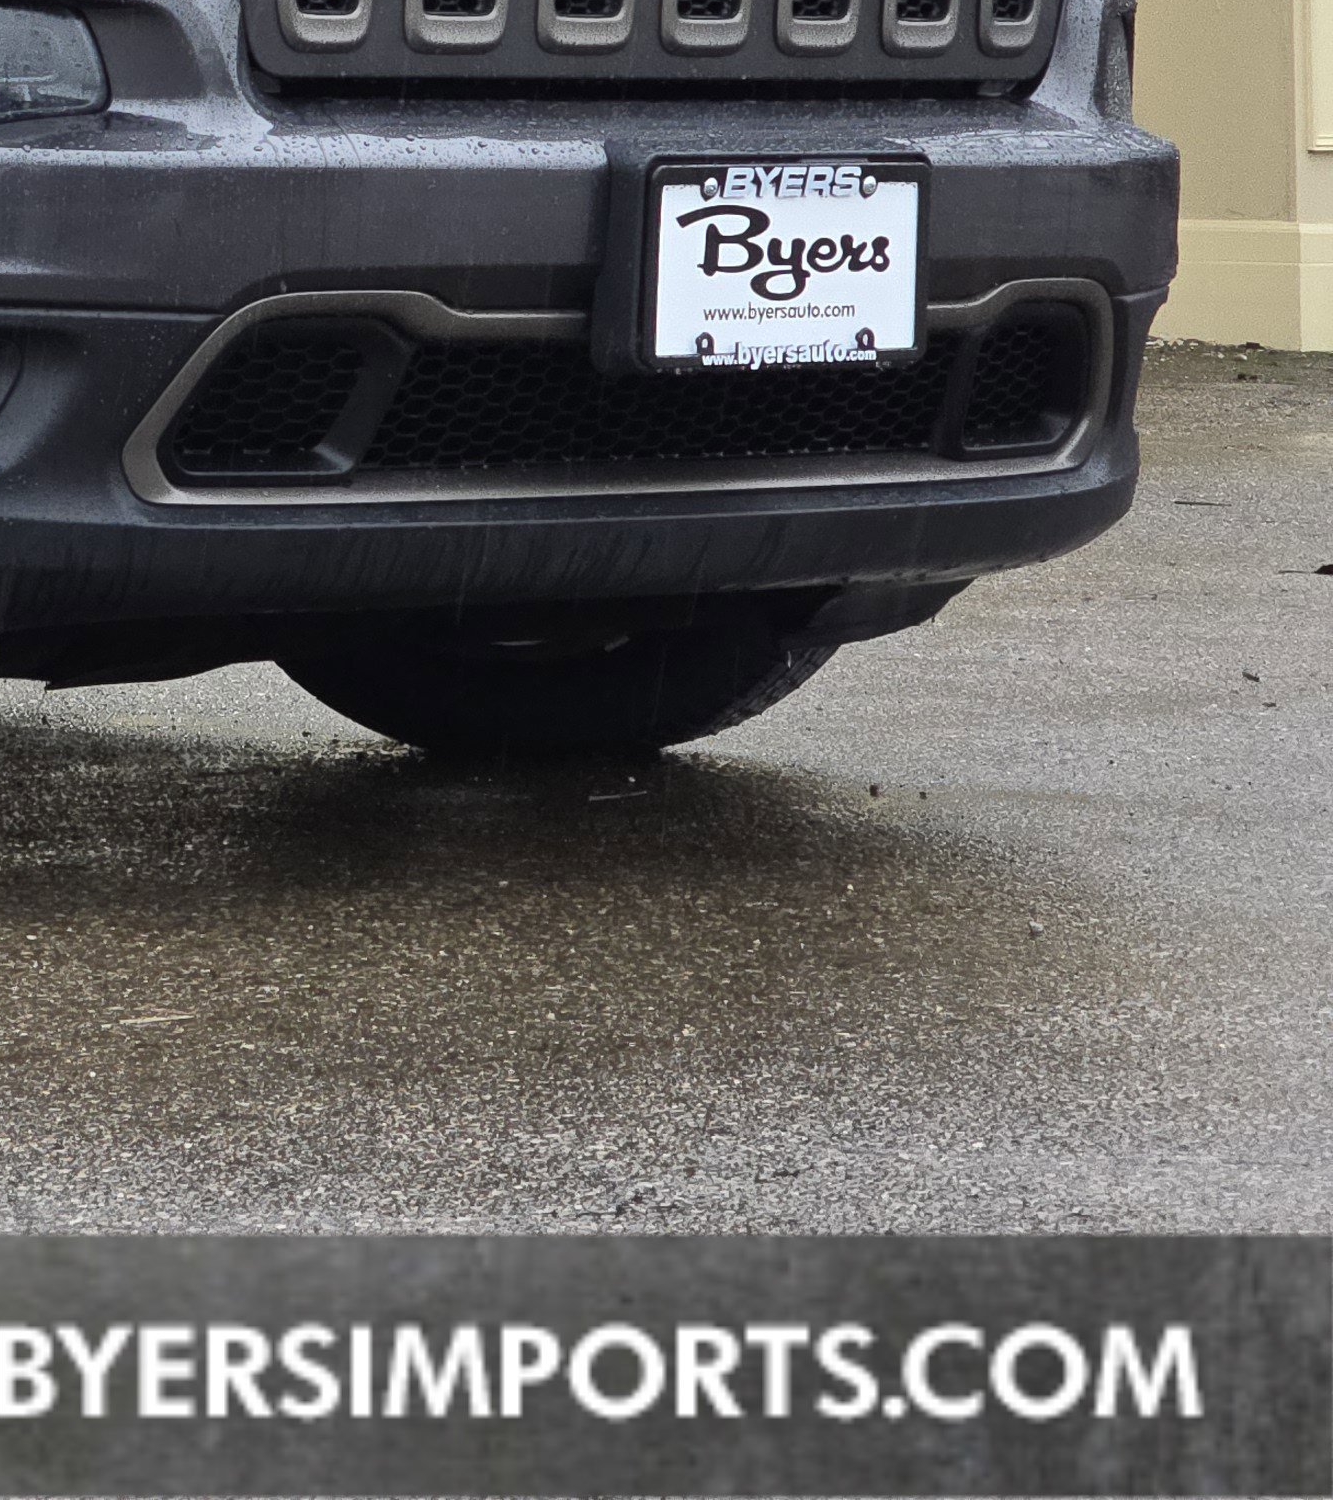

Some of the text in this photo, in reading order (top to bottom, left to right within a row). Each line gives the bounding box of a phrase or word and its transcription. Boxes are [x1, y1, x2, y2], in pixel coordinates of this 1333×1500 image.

[721, 166, 862, 199] BYERS
[675, 204, 891, 301] Byers
[702, 301, 856, 325] www.byersauto.com
[701, 340, 877, 370] www.byersauto.com
